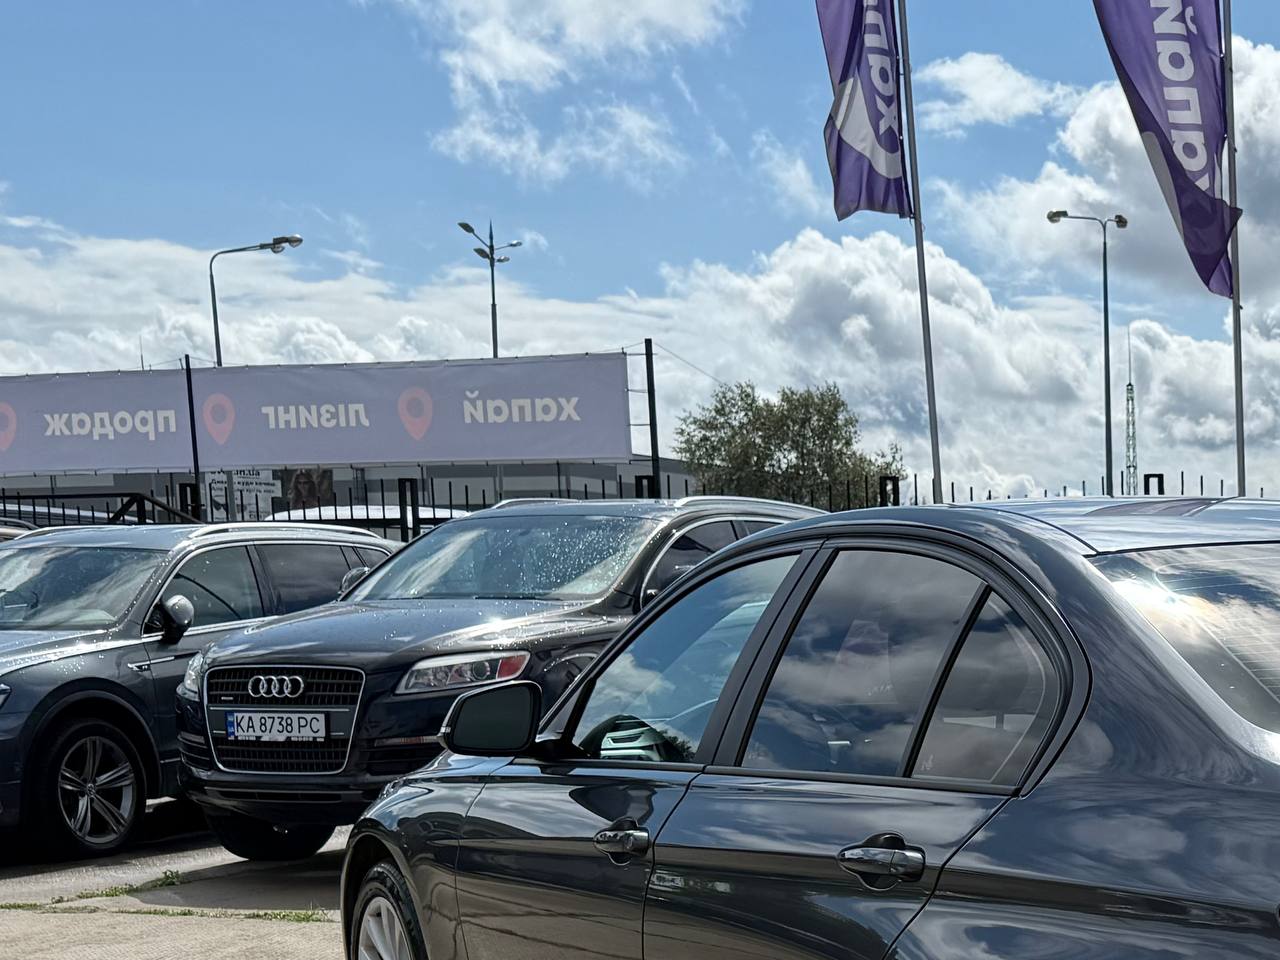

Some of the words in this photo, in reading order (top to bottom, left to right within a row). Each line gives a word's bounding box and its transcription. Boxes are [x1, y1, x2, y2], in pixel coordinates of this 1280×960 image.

[235, 715, 256, 733] KA
[260, 716, 293, 734] 8738
[297, 716, 320, 734] PC
